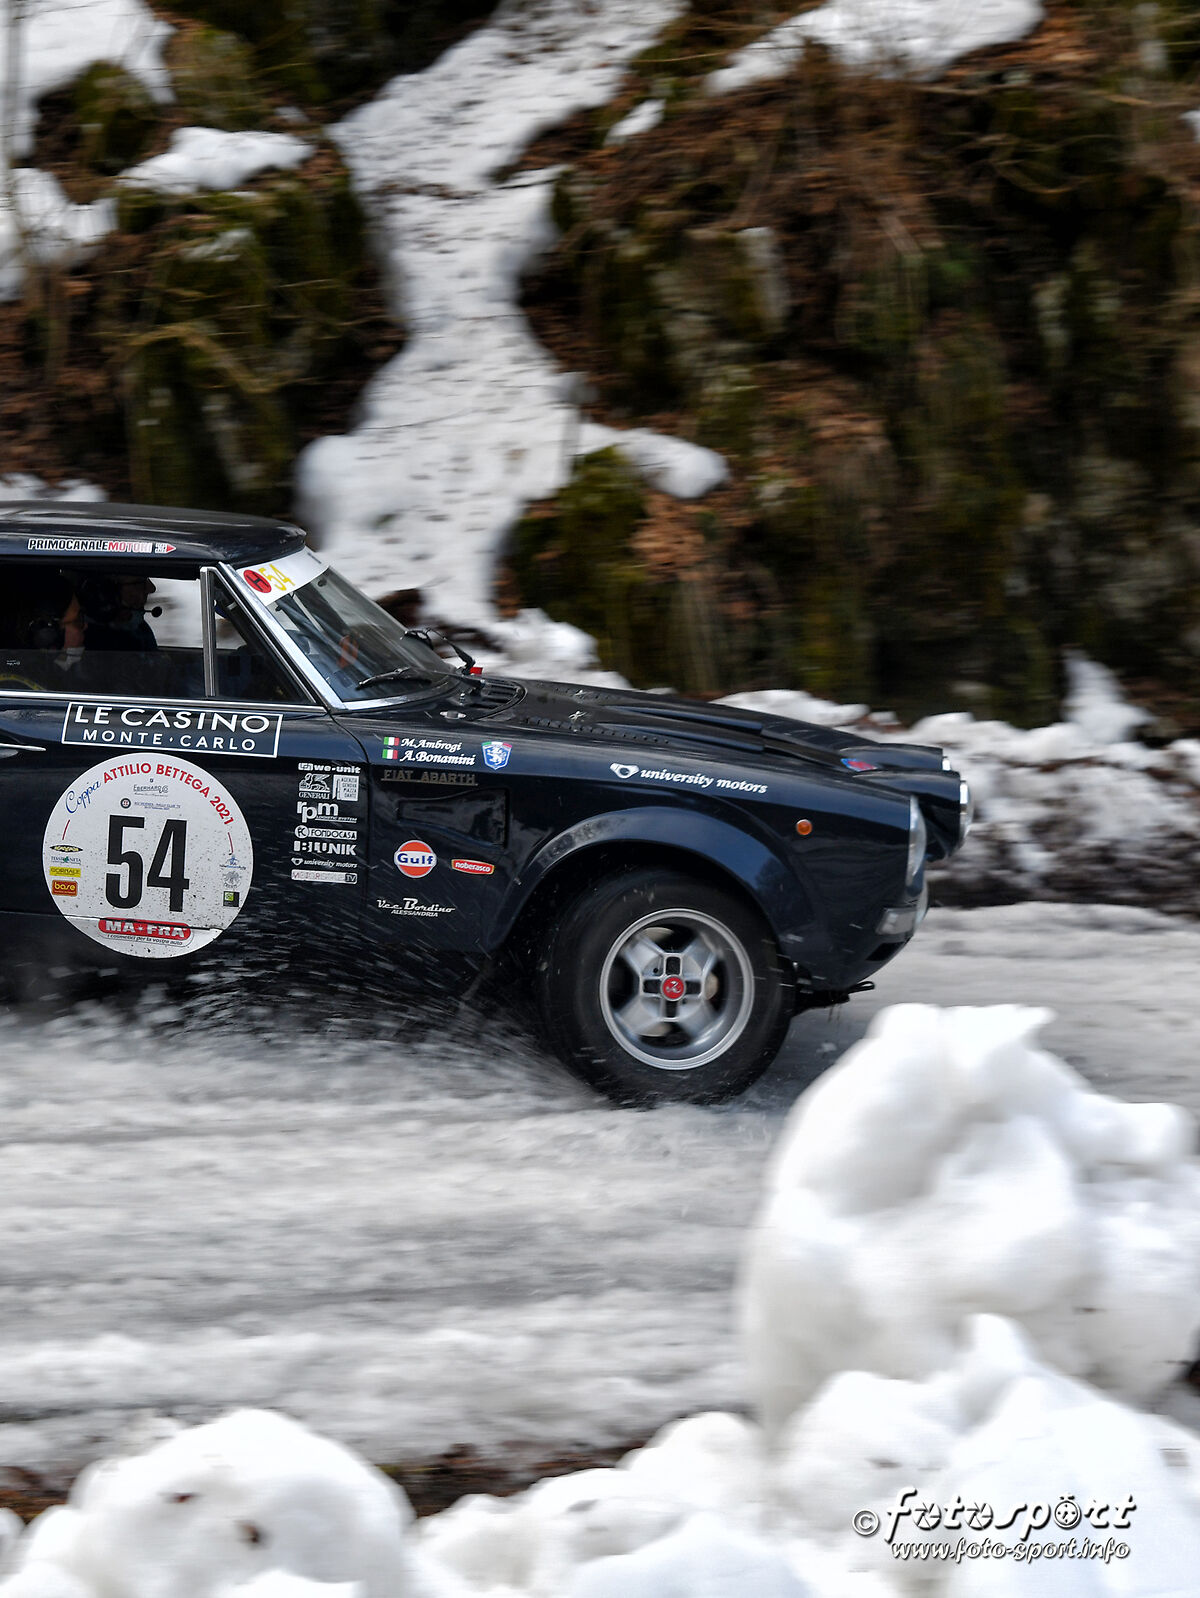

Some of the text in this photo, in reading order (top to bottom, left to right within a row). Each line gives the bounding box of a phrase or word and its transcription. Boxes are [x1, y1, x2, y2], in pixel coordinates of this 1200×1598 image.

[258, 564, 295, 591] 54
[74, 705, 270, 734] LE CASINO
[83, 729, 256, 750] MONTE CARLO
[401, 738, 463, 753] M.Ambrogi
[400, 749, 476, 766] A.Bonamini
[383, 769, 476, 784] FIAT ABARTH
[640, 769, 768, 794] university motors
[65, 762, 235, 825] Coppa ATTILIO BETTEGA 2021
[299, 791, 330, 799] GENERALI
[296, 801, 339, 823] rpm
[311, 829, 356, 839] FONDOCASA
[105, 814, 190, 912] 54
[304, 858, 336, 868] university
[397, 852, 434, 864] Gulf
[455, 862, 491, 872] noberasco
[391, 909, 438, 917] ALESSANDRIA
[403, 897, 455, 913] Bordino
